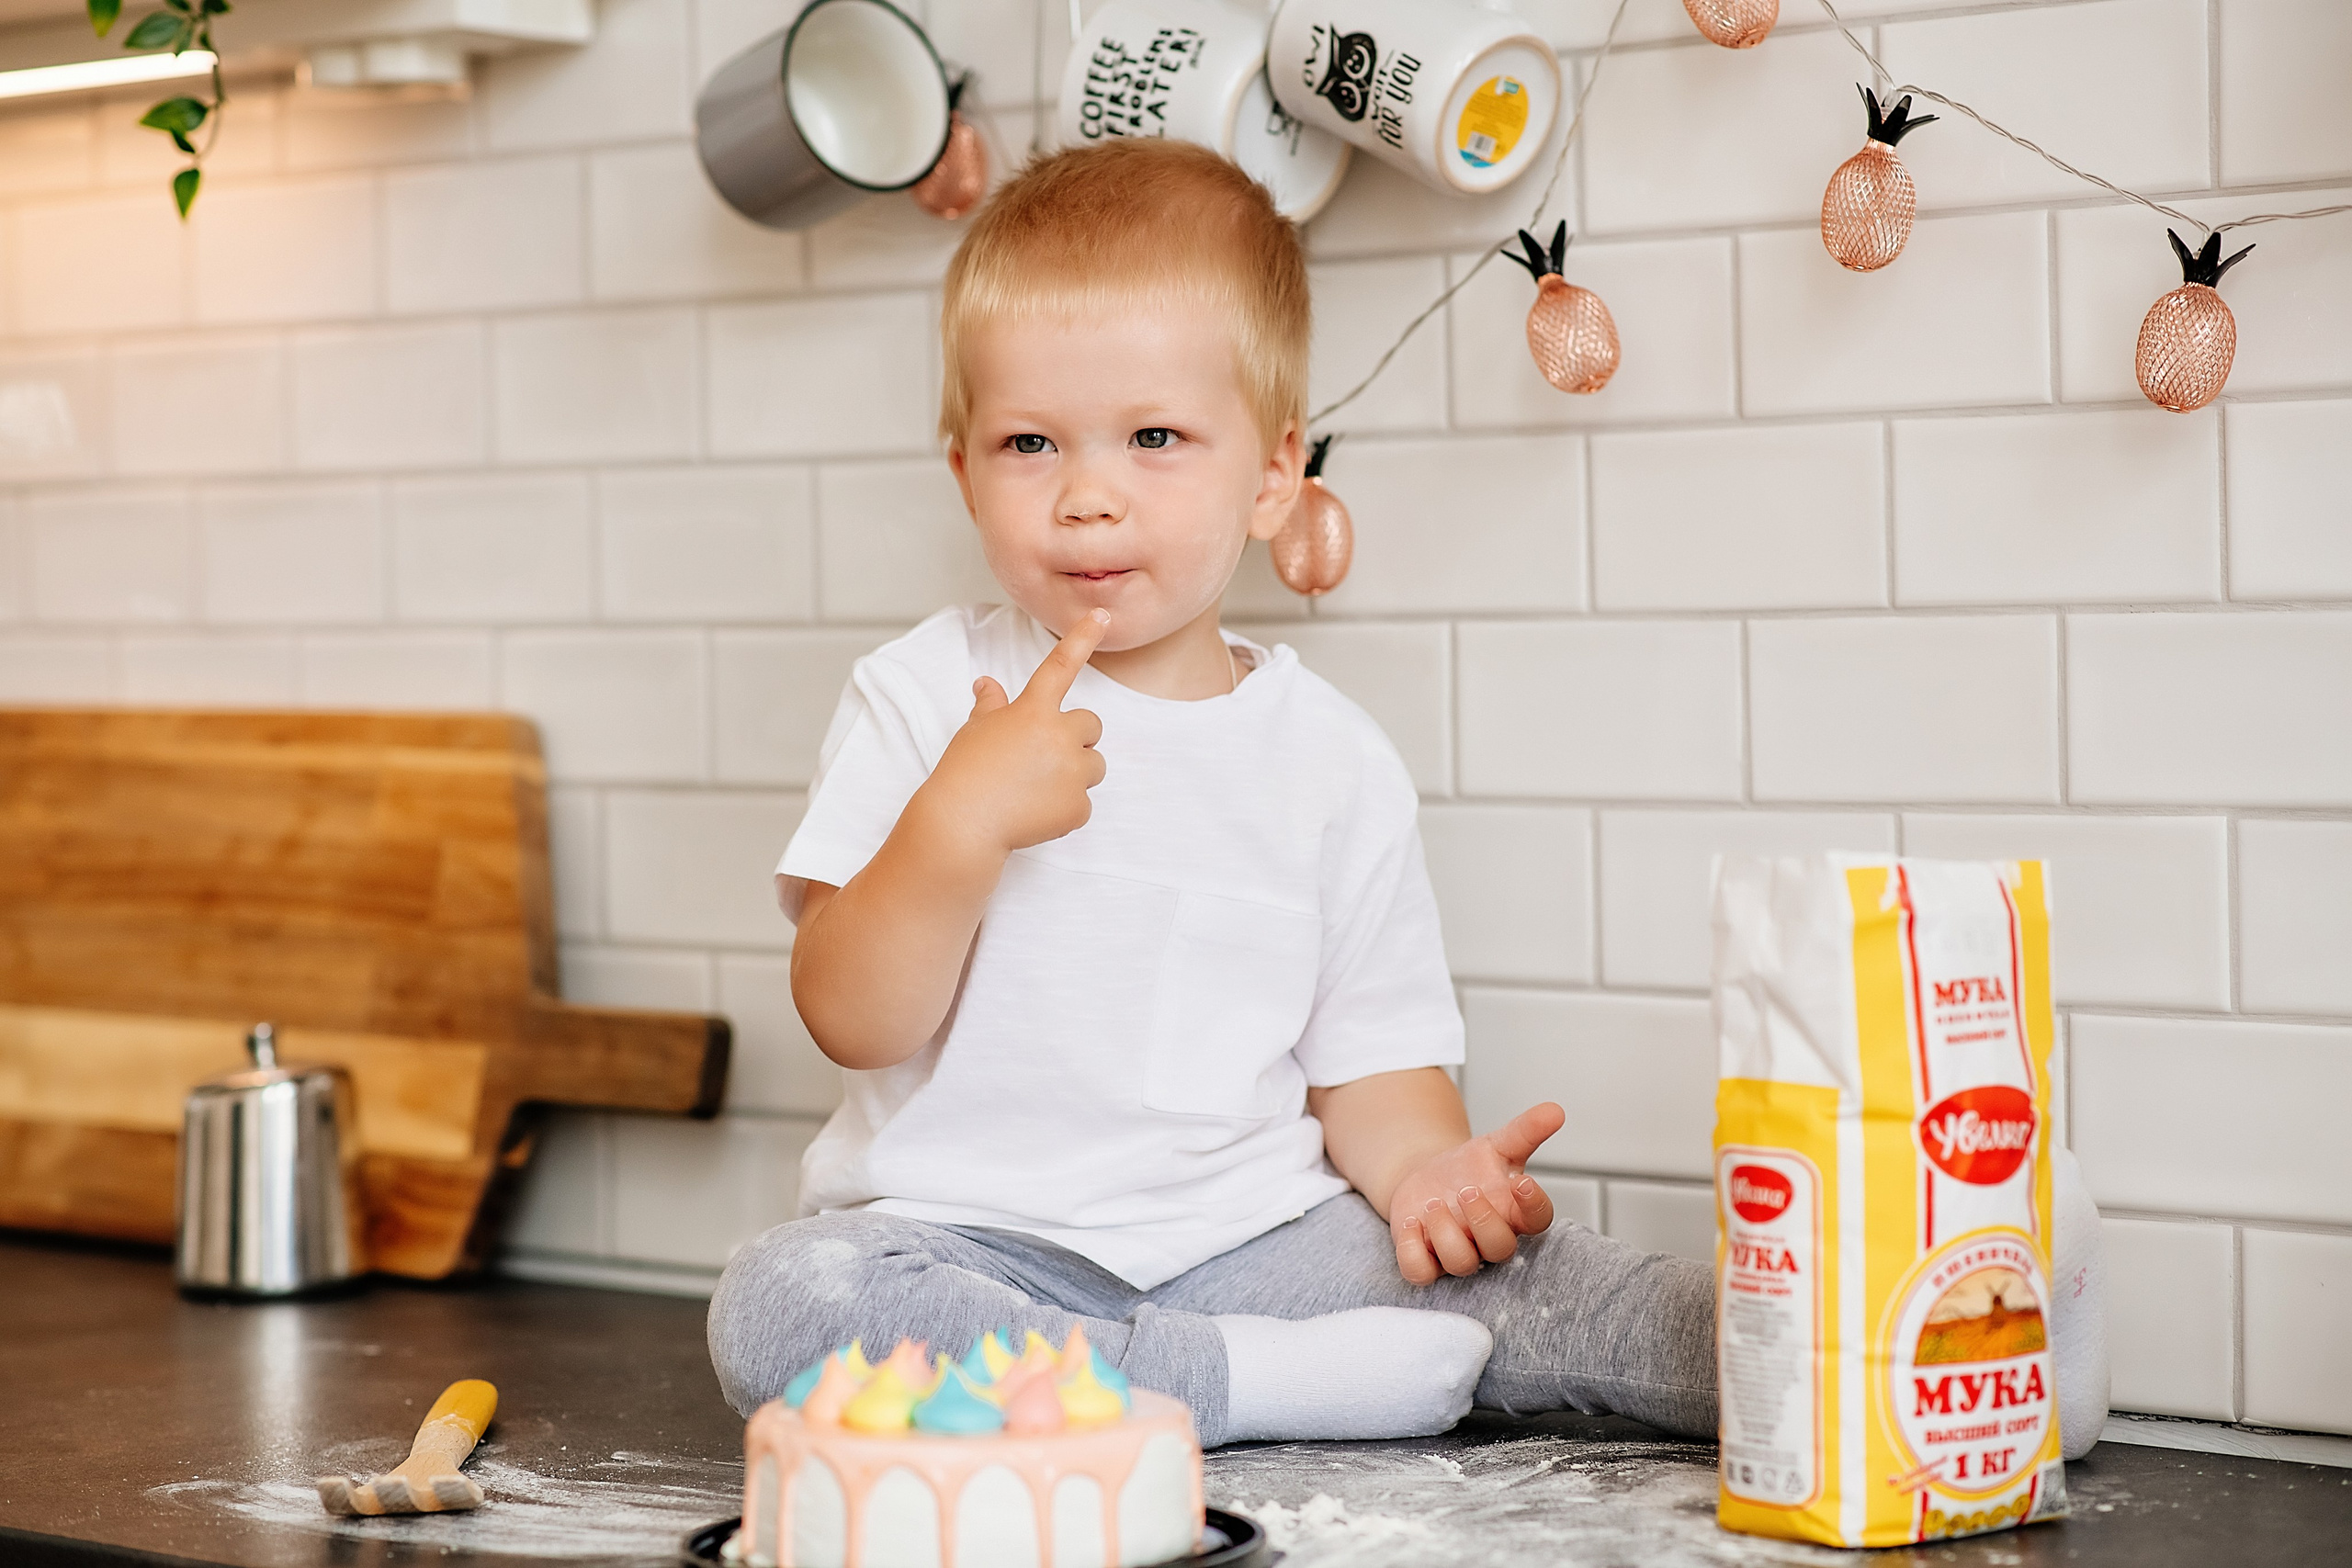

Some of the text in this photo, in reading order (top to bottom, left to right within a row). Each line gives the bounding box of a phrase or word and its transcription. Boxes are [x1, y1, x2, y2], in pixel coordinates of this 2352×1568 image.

[1080, 37, 1124, 139] COFFEE
[1105, 51, 1138, 136] FIRST
[1128, 29, 1173, 135] ROBLEMS
[1934, 976, 2007, 1007] МУКА
[1914, 1362, 2045, 1416] МУКА
[1955, 1453, 1969, 1480] 1
